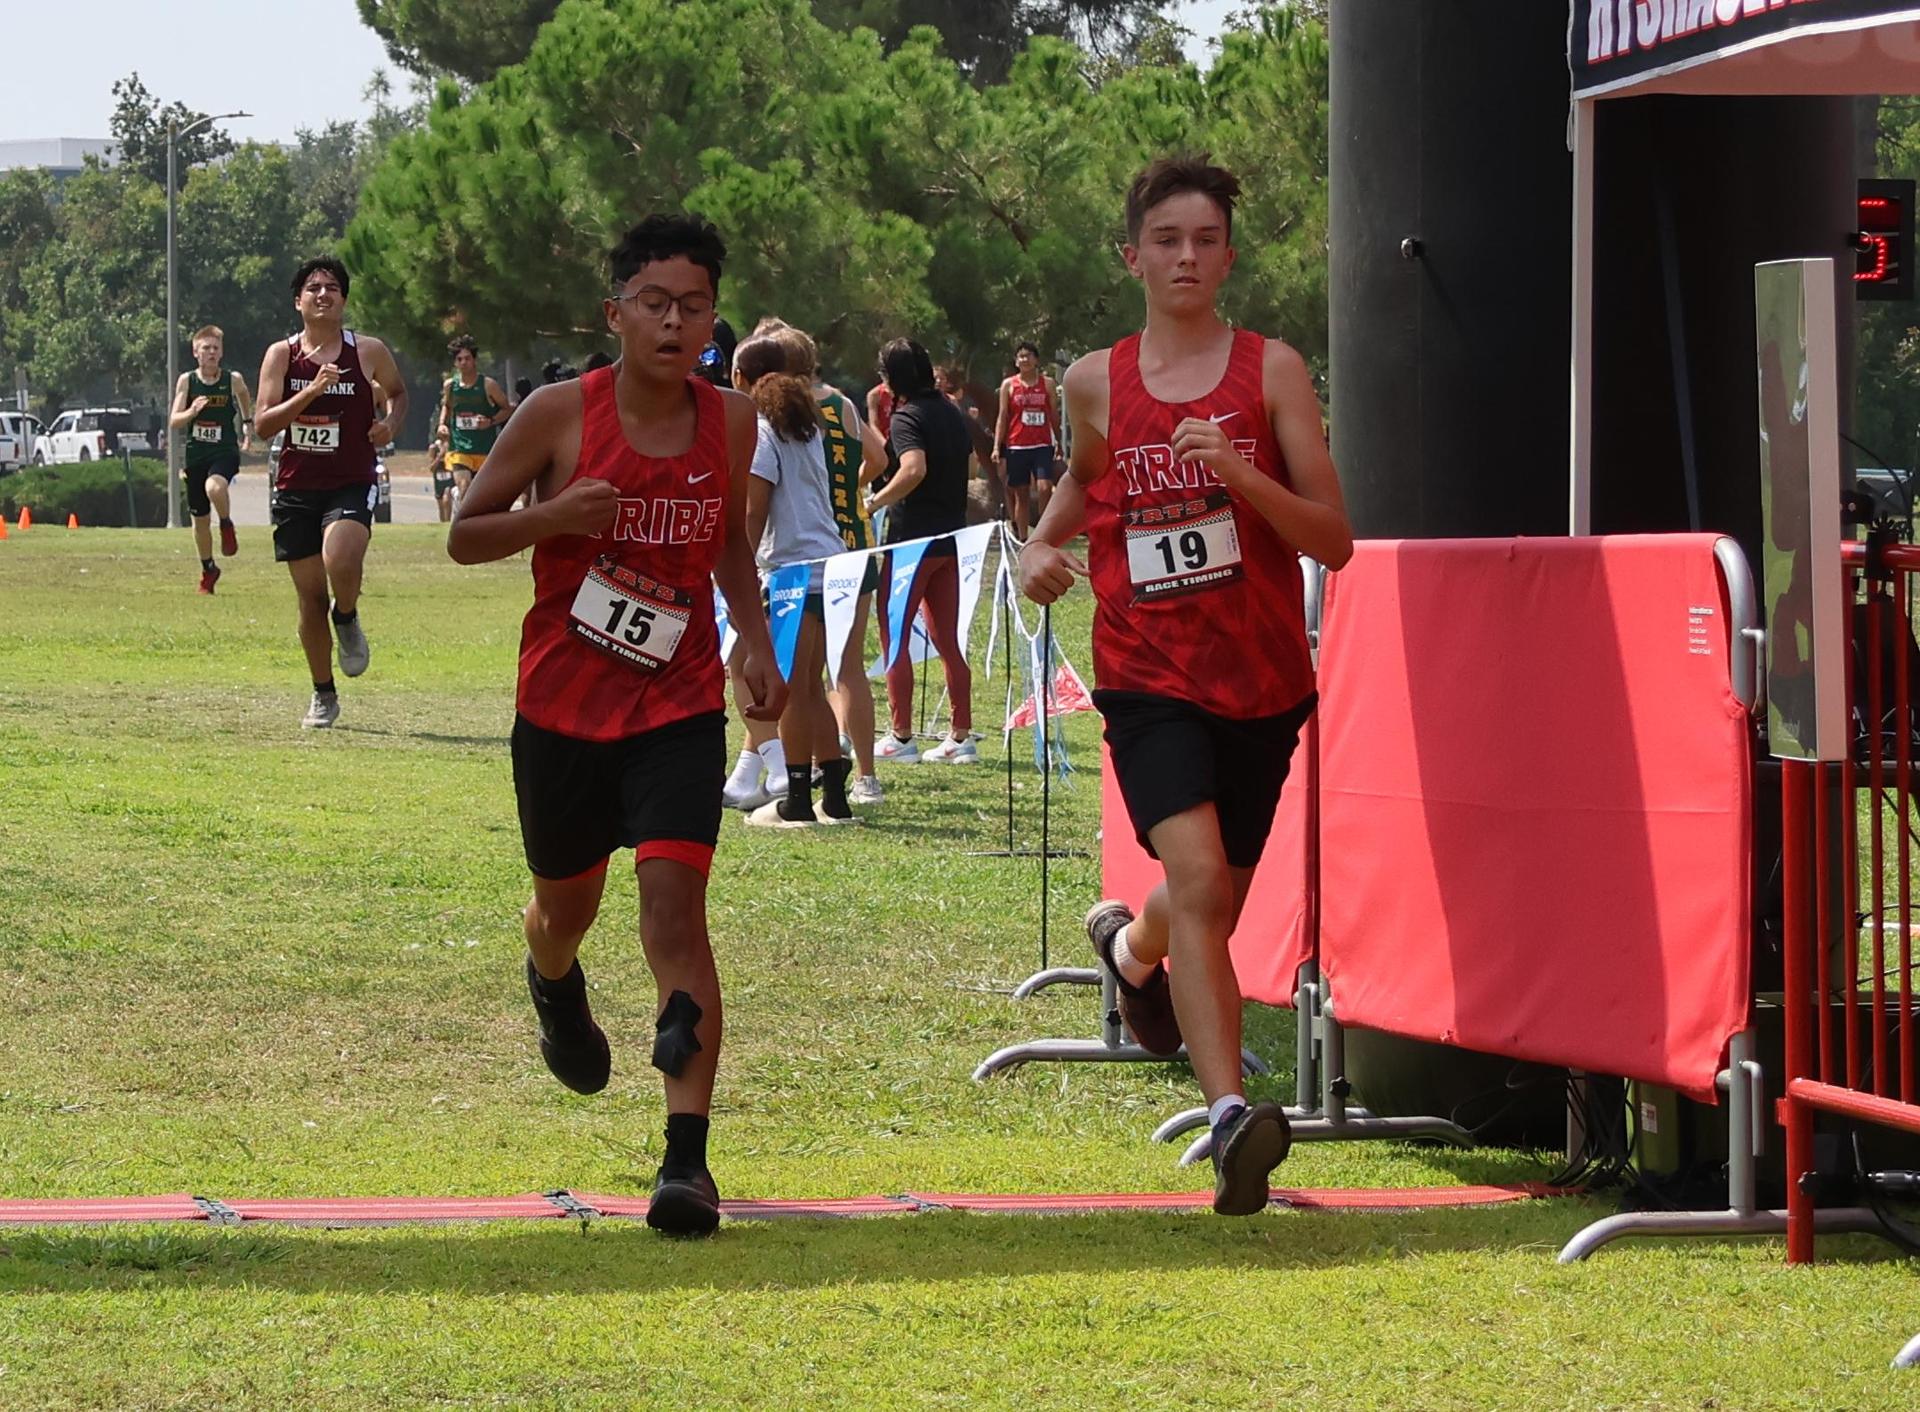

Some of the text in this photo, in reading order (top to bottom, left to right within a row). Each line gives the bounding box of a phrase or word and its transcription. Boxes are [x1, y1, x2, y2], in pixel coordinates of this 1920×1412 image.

[198, 428, 217, 438] 148
[298, 427, 331, 446] 742
[588, 497, 722, 544] RIBE
[1142, 499, 1208, 523] RTS
[1155, 530, 1208, 574] 19
[612, 565, 676, 601] RTS
[827, 577, 859, 590] BROOKS
[1145, 568, 1233, 593] RACE TIMING
[774, 587, 805, 601] BROOKS
[604, 598, 656, 646] 15
[576, 624, 658, 669] RACE TIMING
